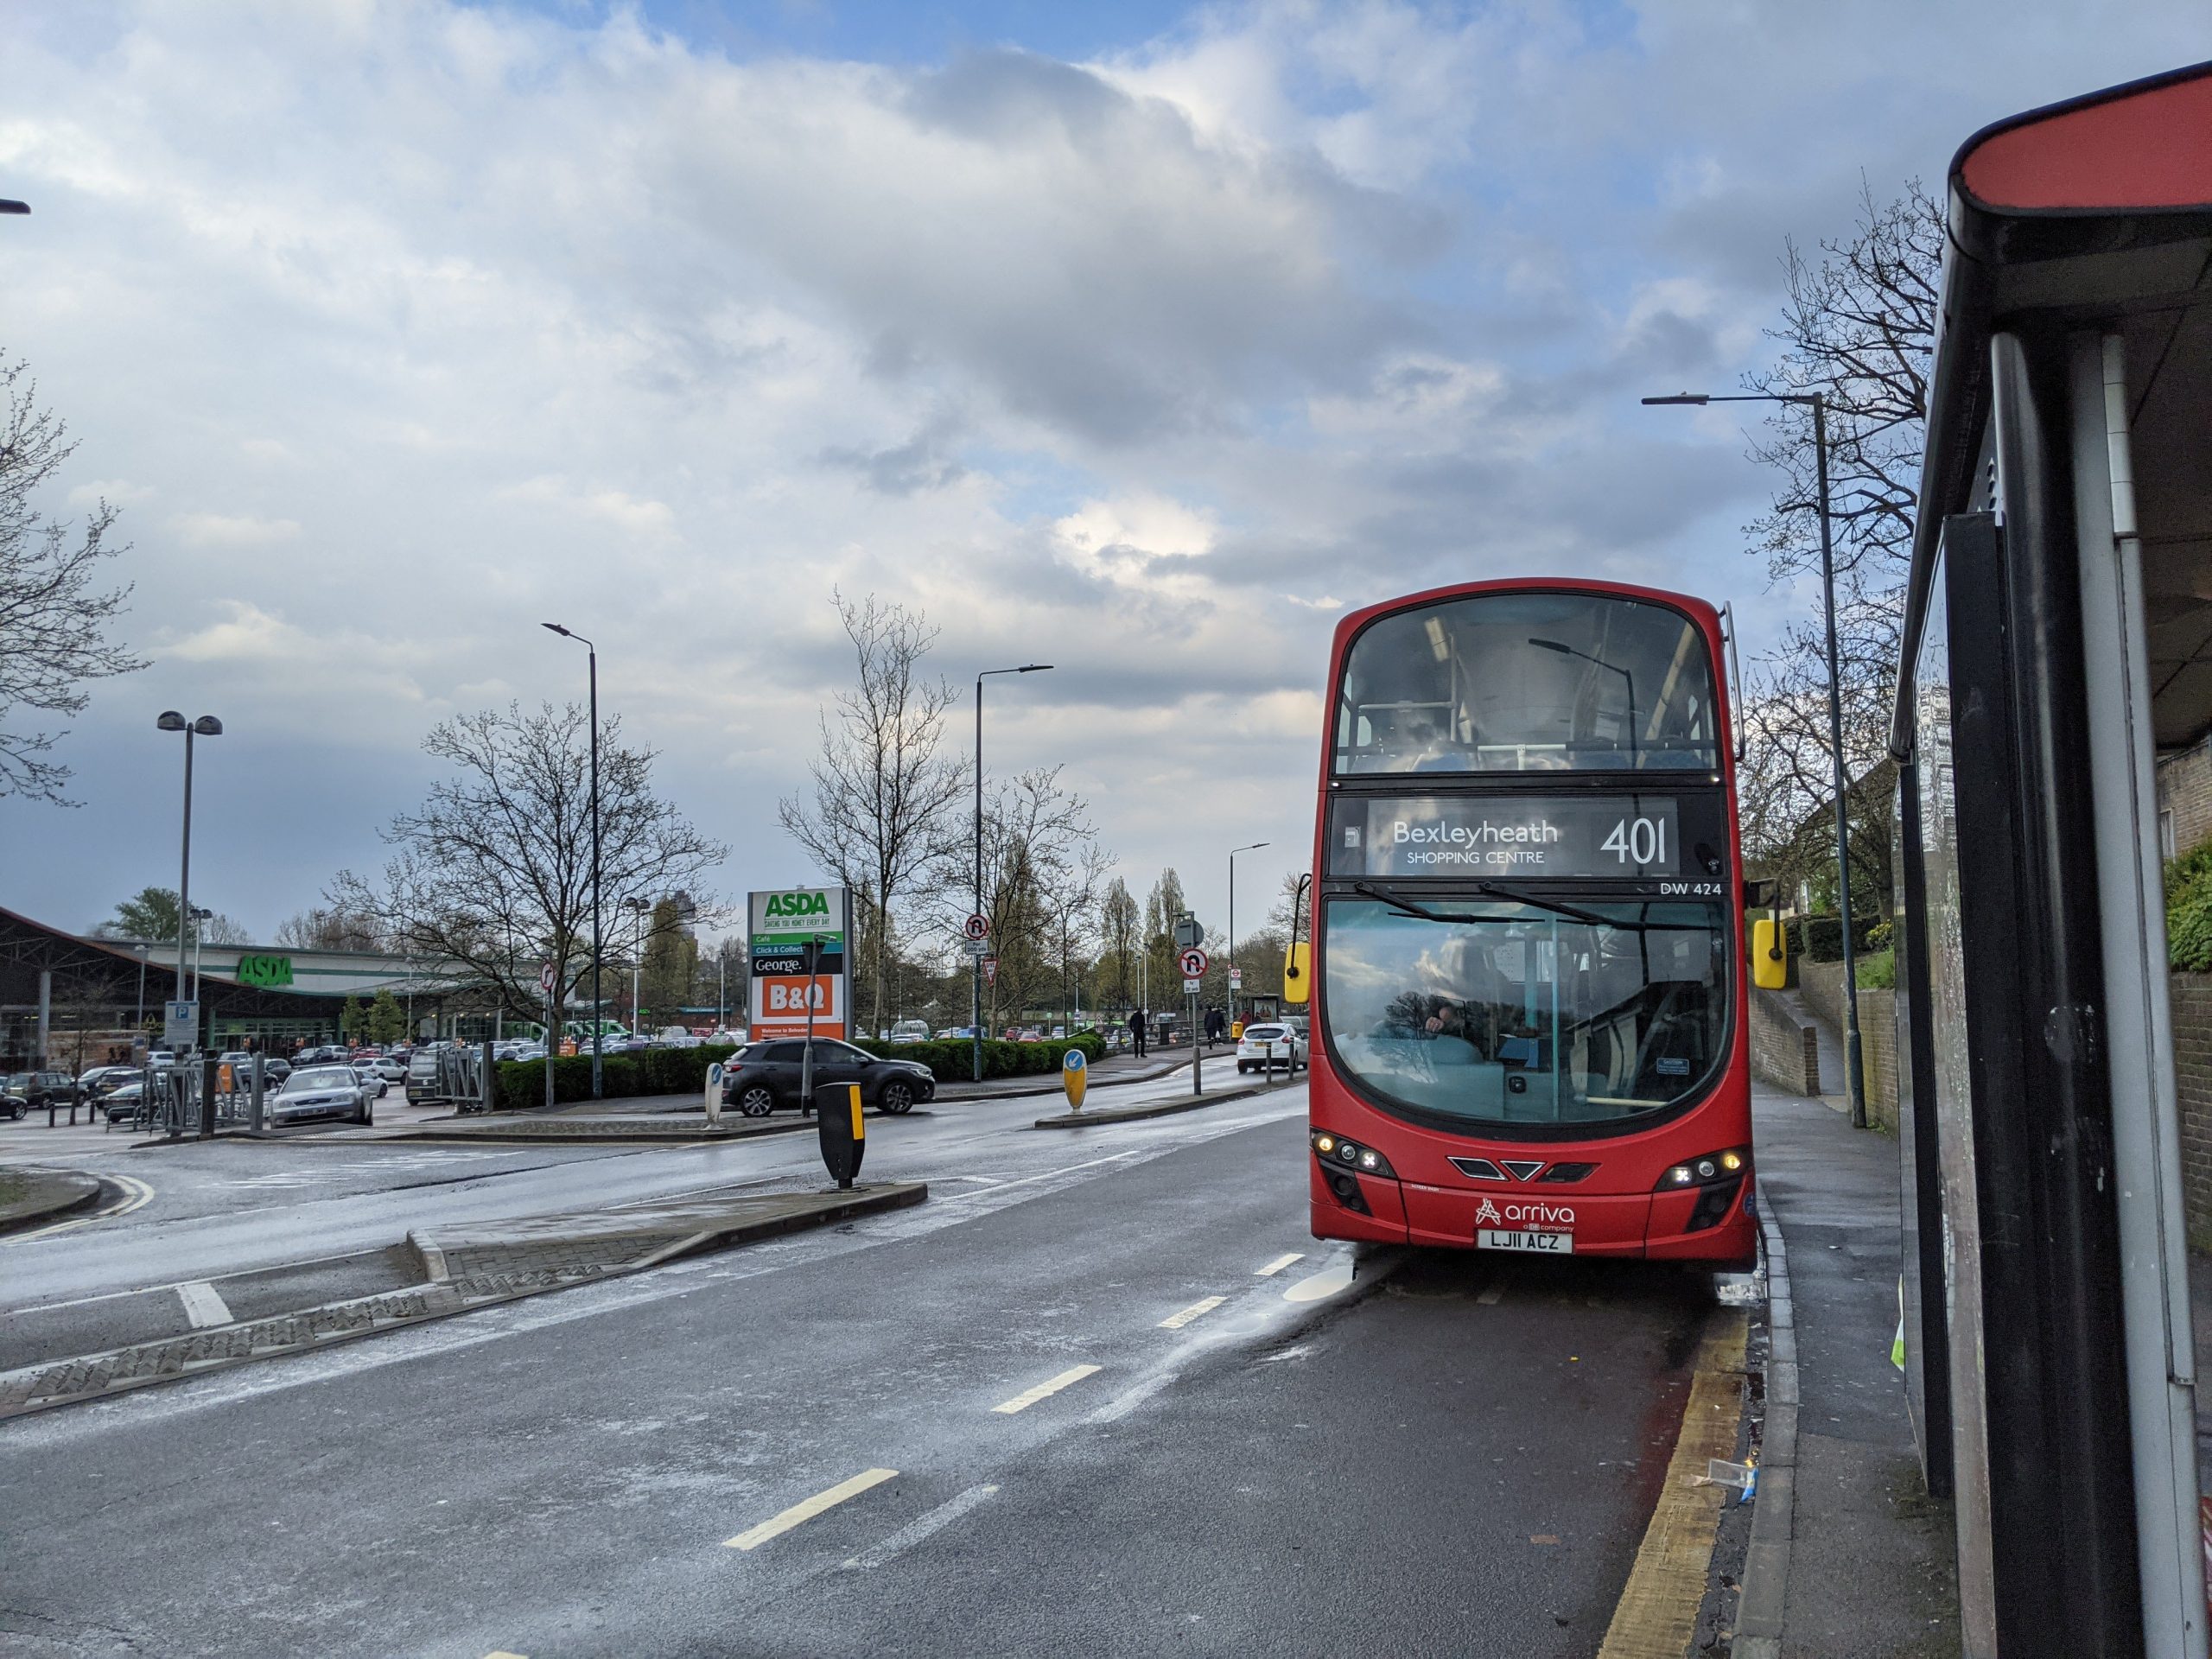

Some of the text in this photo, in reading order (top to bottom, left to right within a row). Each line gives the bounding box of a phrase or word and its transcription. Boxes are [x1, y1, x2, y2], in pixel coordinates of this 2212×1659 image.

[1394, 817, 1665, 864] Bexleyheath 401
[1407, 851, 1545, 864] SHOPPING CENTRE
[1661, 883, 1722, 895] DW 424
[765, 893, 830, 917] ASDA
[238, 956, 294, 985] ASDA
[755, 959, 803, 974] George.
[770, 983, 824, 1010] B&Q
[1505, 1203, 1574, 1223] arriva
[1491, 1232, 1559, 1249] LJ11 ACZ
